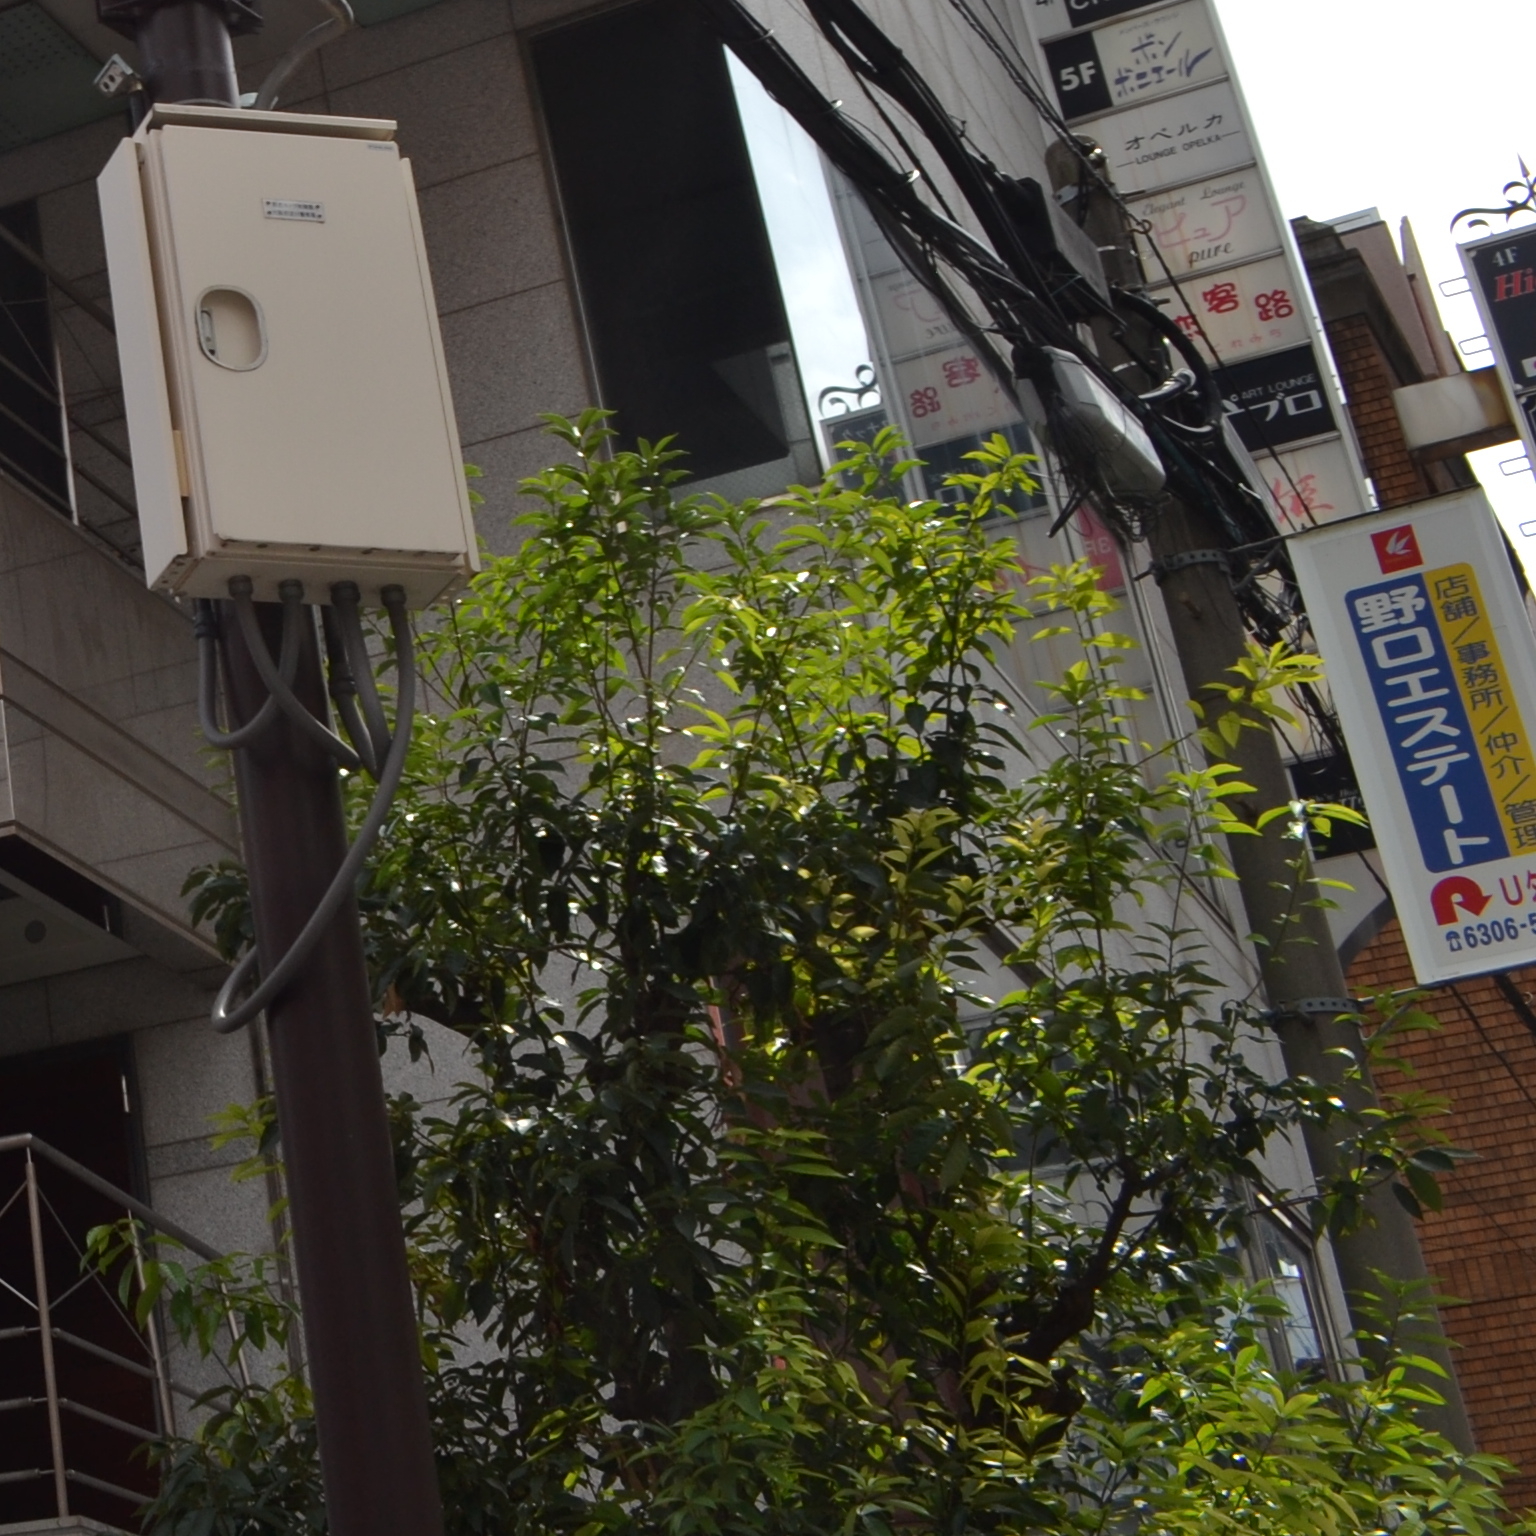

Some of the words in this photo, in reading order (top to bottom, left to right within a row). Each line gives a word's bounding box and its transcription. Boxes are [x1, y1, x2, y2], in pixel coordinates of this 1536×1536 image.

[1059, 60, 1096, 91] 5F
[1135, 146, 1177, 165] LOUNGE
[1182, 133, 1222, 152] OPELKA
[1142, 197, 1186, 216] Elegant
[1199, 182, 1245, 200] Lounge
[1492, 246, 1518, 267] 4F
[1494, 267, 1536, 302] Hi
[1241, 387, 1265, 400] ART
[1267, 373, 1318, 395] LOUNGE
[1354, 585, 1490, 865] 野口エステート
